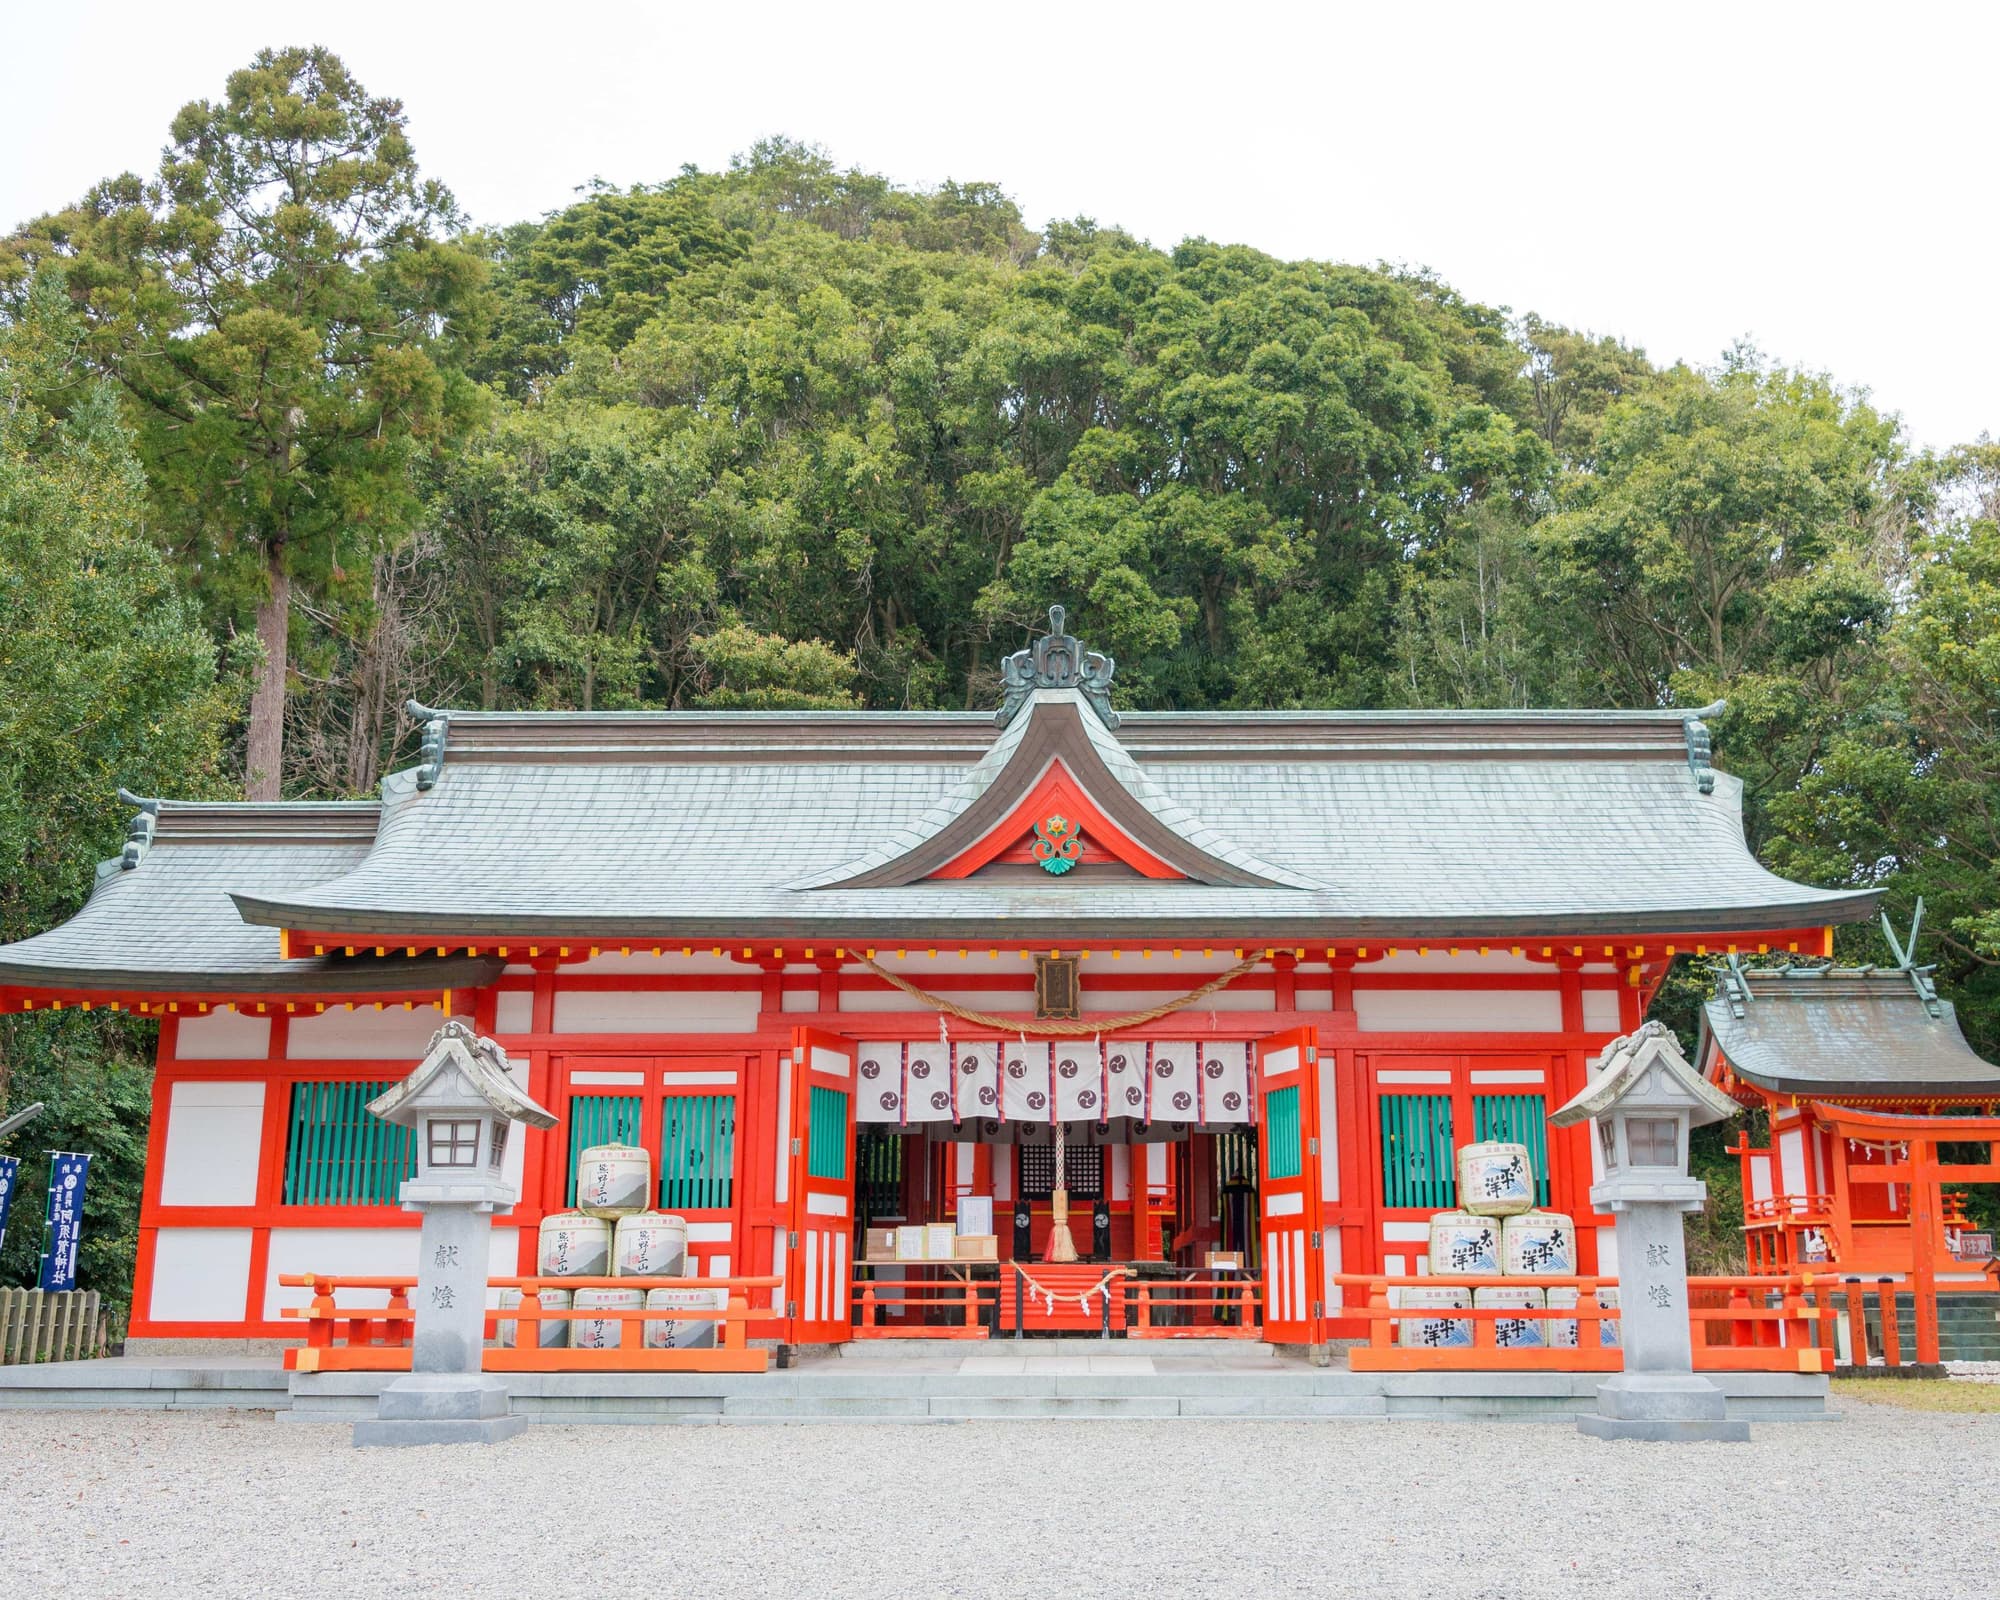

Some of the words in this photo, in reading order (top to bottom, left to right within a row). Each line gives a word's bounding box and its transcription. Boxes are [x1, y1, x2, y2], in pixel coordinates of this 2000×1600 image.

[597, 1163, 608, 1205] 熊野三山
[1485, 1155, 1523, 1199] 太平洋
[557, 1231, 569, 1273] 熊野三山
[638, 1230, 650, 1271] 熊野三山
[1451, 1228, 1493, 1271] 太平洋
[1521, 1228, 1564, 1272] 太平洋
